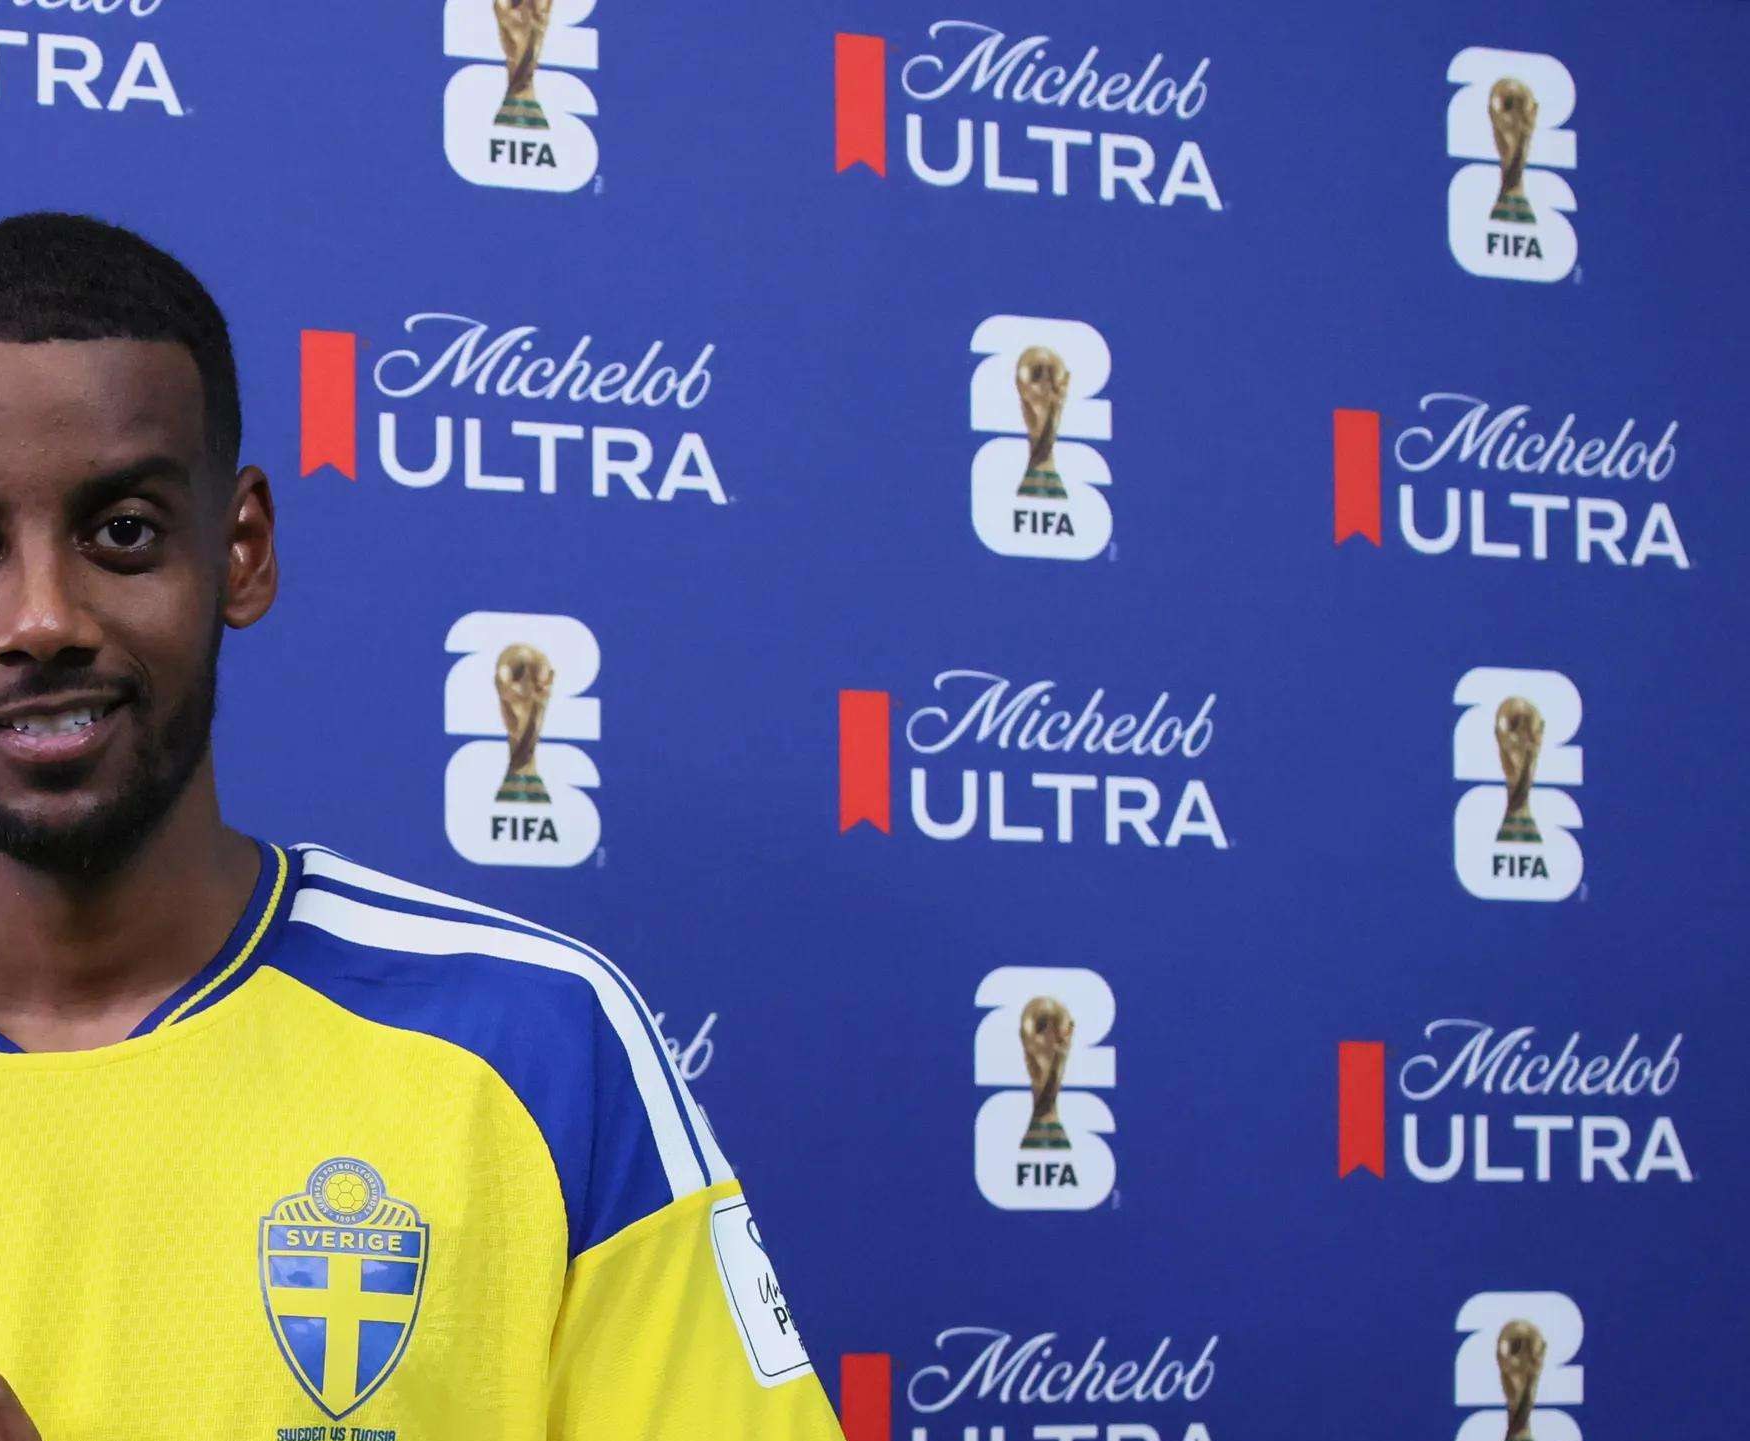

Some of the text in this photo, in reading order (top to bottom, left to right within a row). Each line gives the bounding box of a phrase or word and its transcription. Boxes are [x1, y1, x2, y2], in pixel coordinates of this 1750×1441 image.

[901, 19, 1211, 120] Michelob
[490, 138, 557, 168] FIFA
[905, 112, 1224, 212] ULTRA
[1486, 232, 1543, 260] FIFA
[373, 312, 716, 409] Michelob
[377, 411, 729, 506] ULTRA
[1394, 392, 1679, 482] Michelob
[1013, 509, 1075, 537] FIFA
[1398, 483, 1691, 570] ULTRA
[905, 669, 1217, 759] Michelob
[491, 816, 559, 843] FIFA
[910, 767, 1230, 850] ULTRA
[1492, 854, 1549, 879] FIFA
[1399, 1018, 1683, 1101] Michelob
[1016, 1163, 1078, 1187] FIFA
[1403, 1113, 1694, 1184] ULTRA
[286, 1229, 403, 1252] SVERIGE
[906, 1326, 1219, 1413] Michelob
